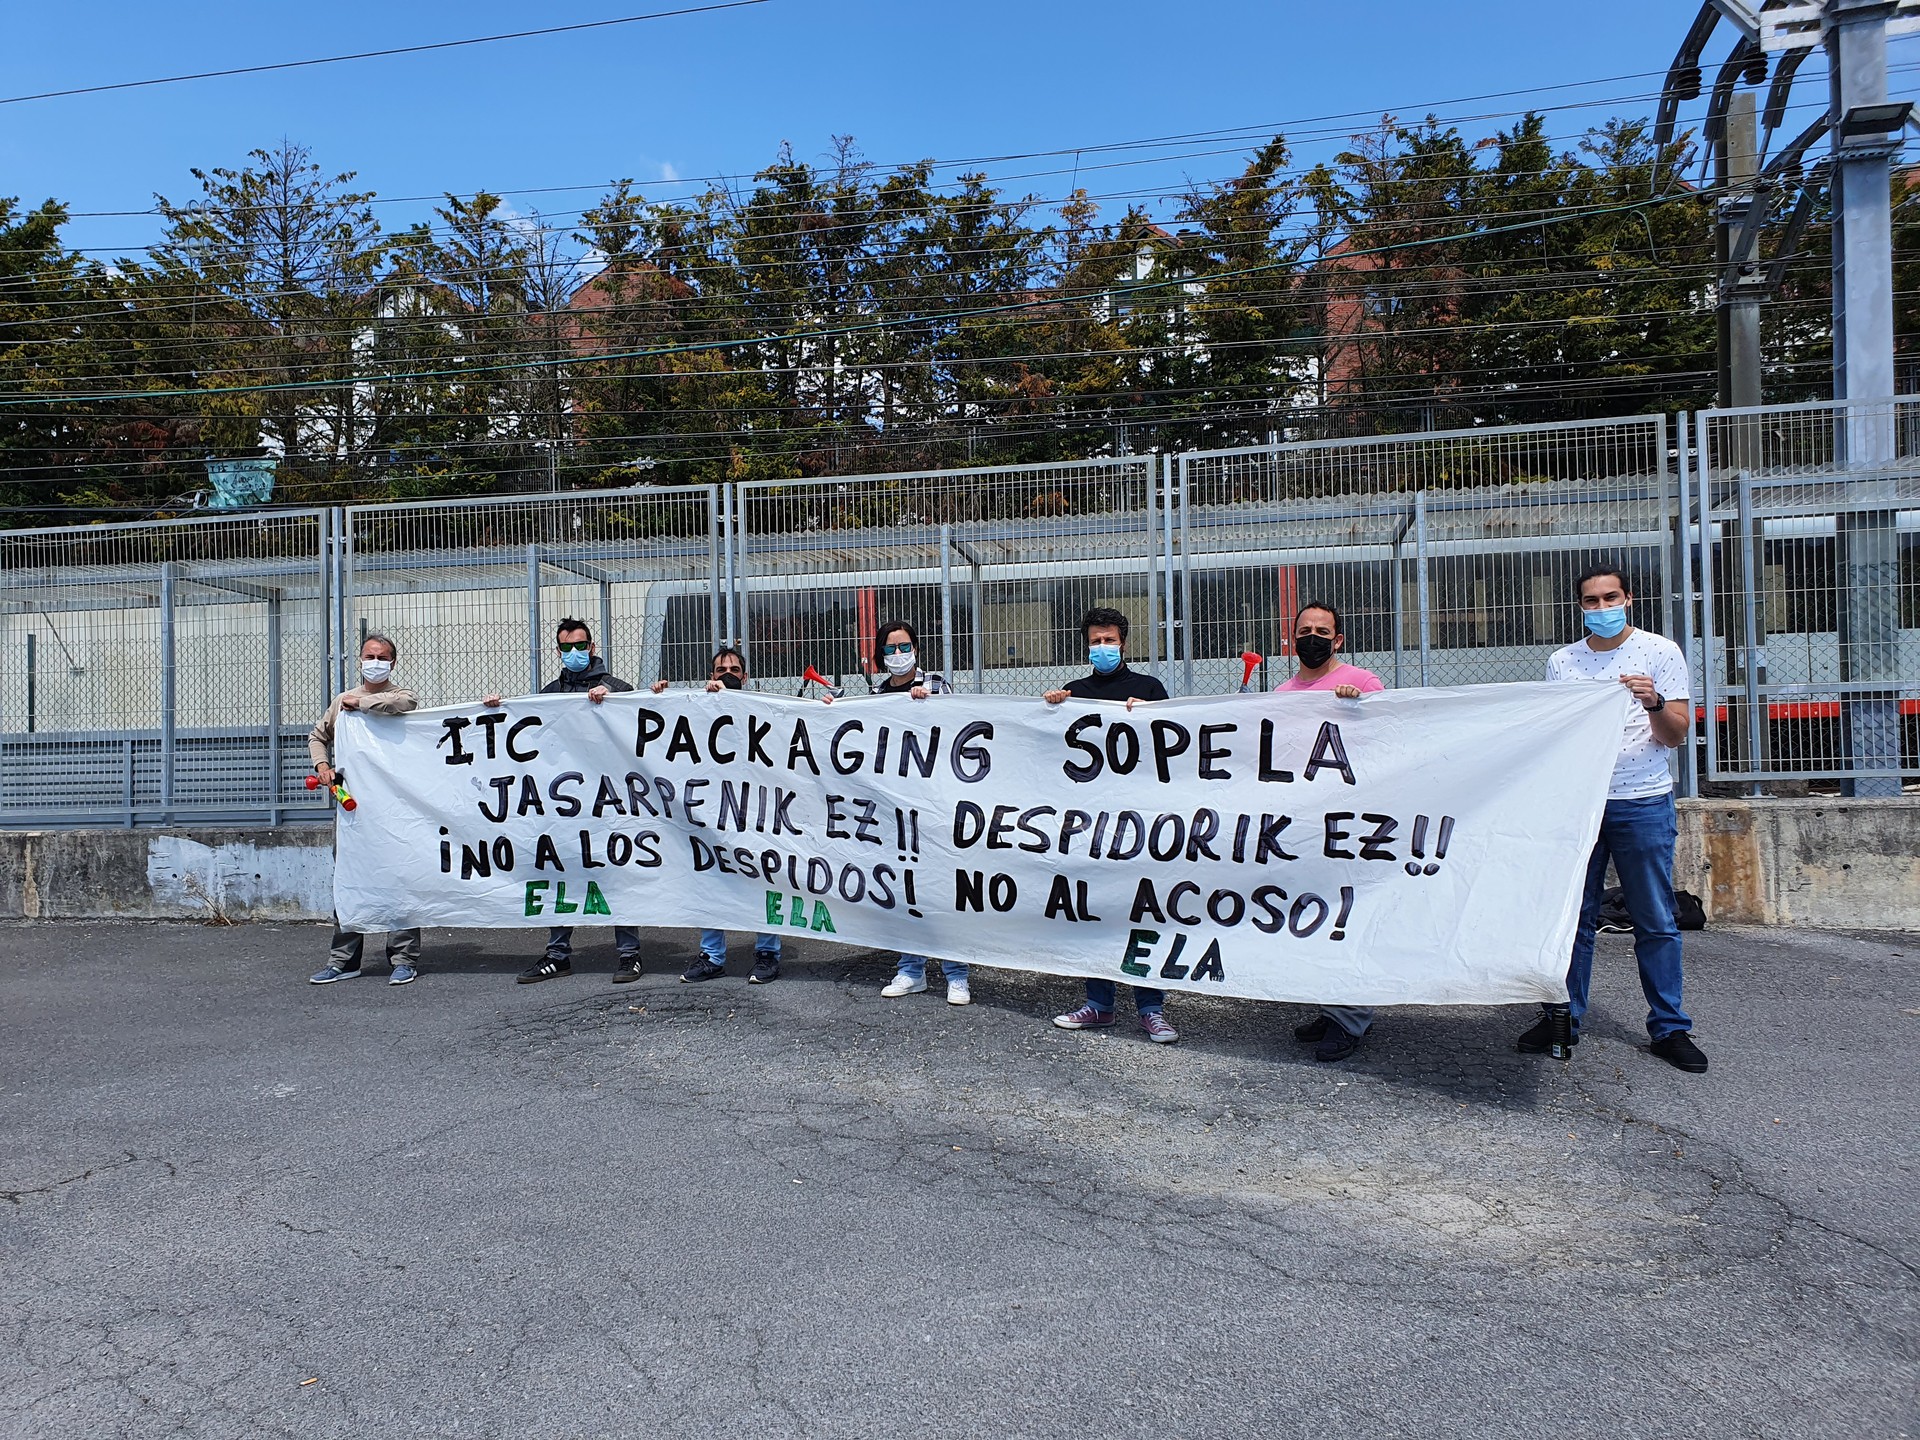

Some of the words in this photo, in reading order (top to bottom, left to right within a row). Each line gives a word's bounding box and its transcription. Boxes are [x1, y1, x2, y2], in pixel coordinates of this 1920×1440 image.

[437, 713, 542, 764] ITC
[636, 709, 994, 782] PACKAGING
[1063, 714, 1356, 784] SOPELA
[478, 772, 802, 835] JASARPENIK
[826, 795, 919, 863] EZ!!
[954, 801, 1299, 864] DESPIDORIK
[1324, 812, 1454, 876] EZ!!
[525, 880, 612, 916] ELA
[535, 835, 565, 872] A
[580, 830, 662, 868] LOS
[690, 836, 923, 918] DESPIDOS!
[955, 869, 1017, 912] NO
[1045, 875, 1101, 922] AL
[1129, 878, 1354, 940] ACOSO!
[765, 891, 837, 934] ELA
[1121, 930, 1224, 982] ELA
